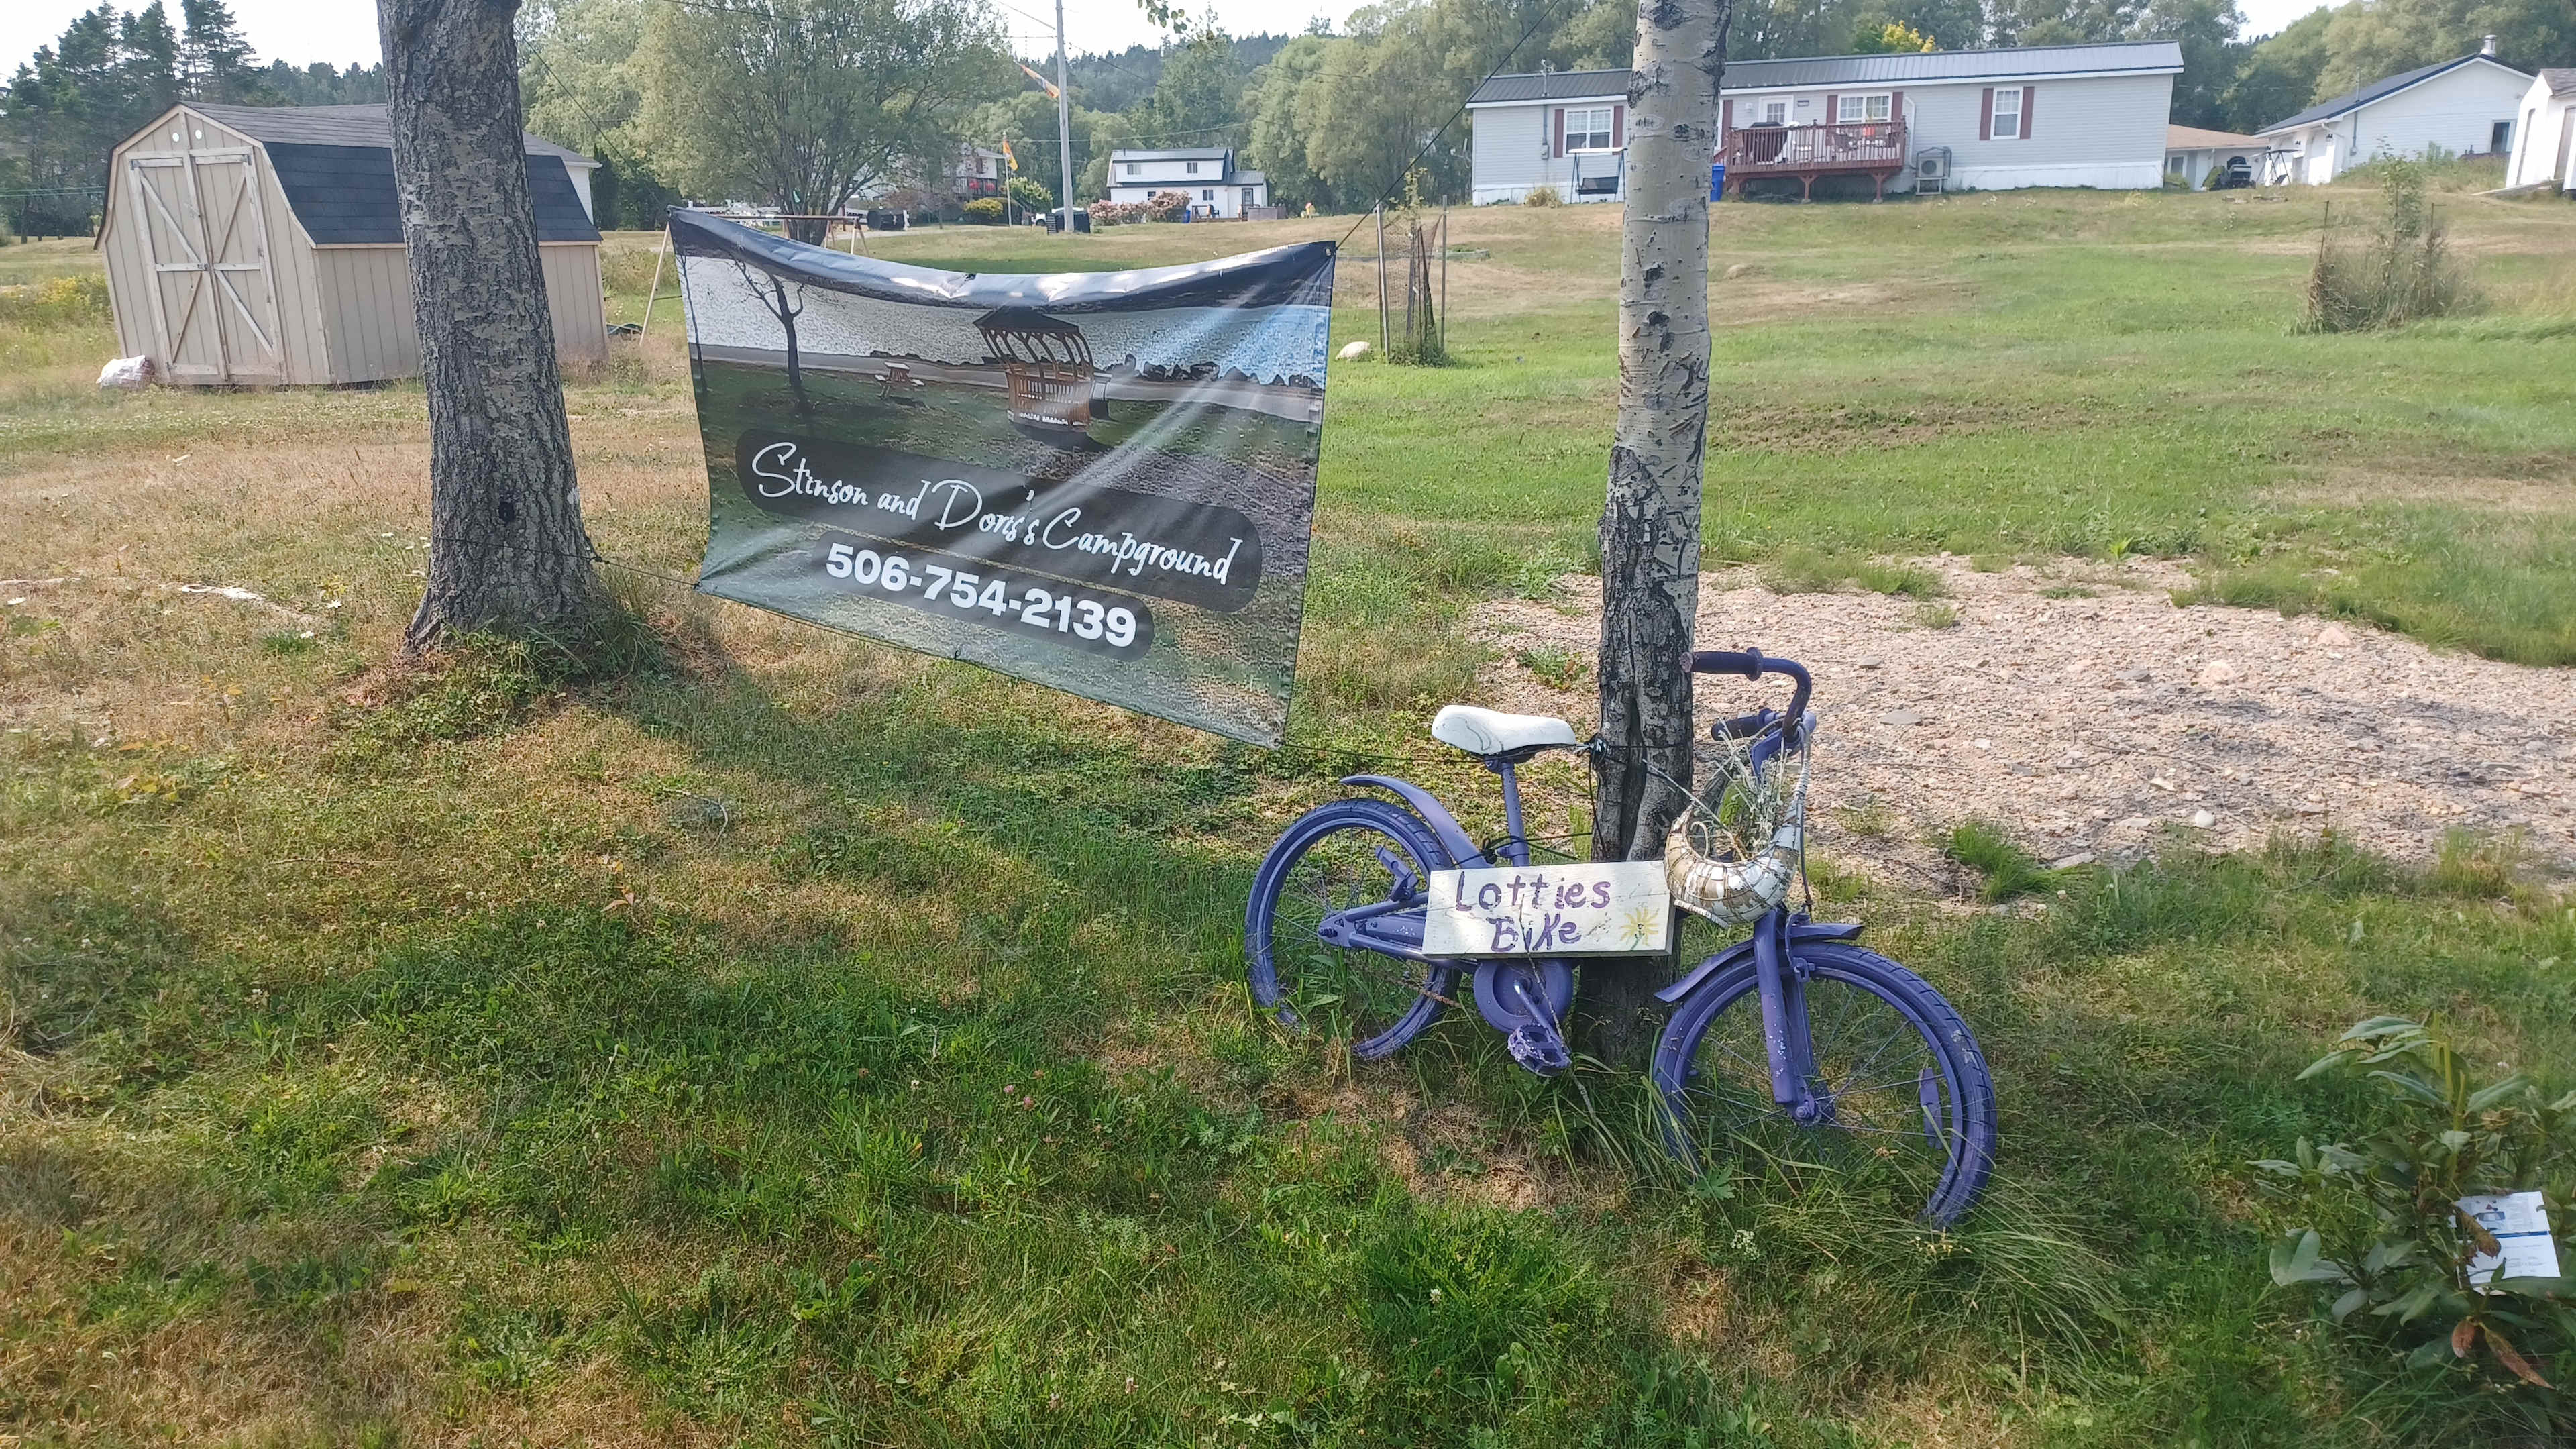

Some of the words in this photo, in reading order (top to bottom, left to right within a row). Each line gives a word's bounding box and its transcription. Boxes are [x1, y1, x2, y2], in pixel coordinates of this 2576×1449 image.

[751, 441, 869, 506] Stinson
[877, 479, 932, 521] and
[932, 479, 1040, 546] Doris's
[1042, 507, 1244, 586] Campground
[826, 542, 1137, 648] 506-754-2139
[1456, 871, 1611, 912] Lotties
